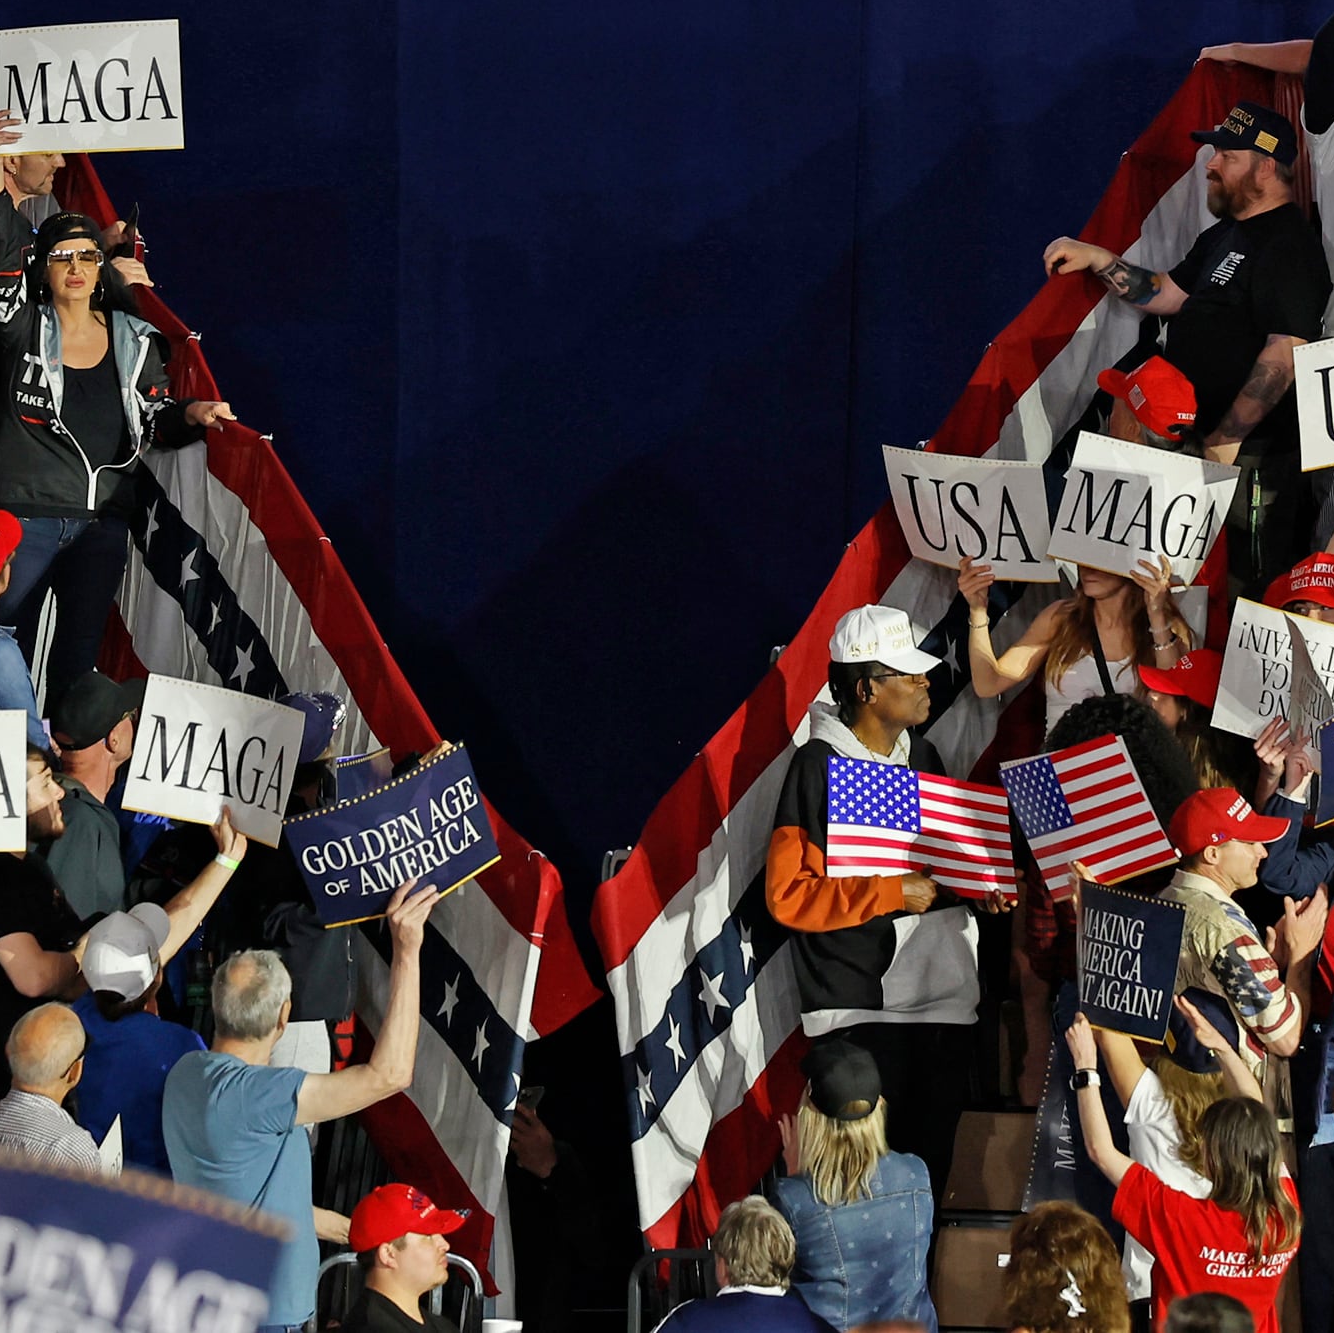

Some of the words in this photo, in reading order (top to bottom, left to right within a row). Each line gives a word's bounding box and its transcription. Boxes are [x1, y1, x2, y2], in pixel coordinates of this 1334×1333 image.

[4, 56, 178, 125] MAGA
[901, 472, 1041, 565] USA
[1061, 469, 1214, 562] MAGA
[136, 712, 285, 817] MAGA
[302, 807, 424, 875] GOLDEN
[430, 776, 479, 832] AGE
[324, 879, 350, 896] OF
[361, 815, 482, 896] AMERICA
[1095, 981, 1163, 1022] AGAIN!
[1199, 1246, 1246, 1264] MAKE
